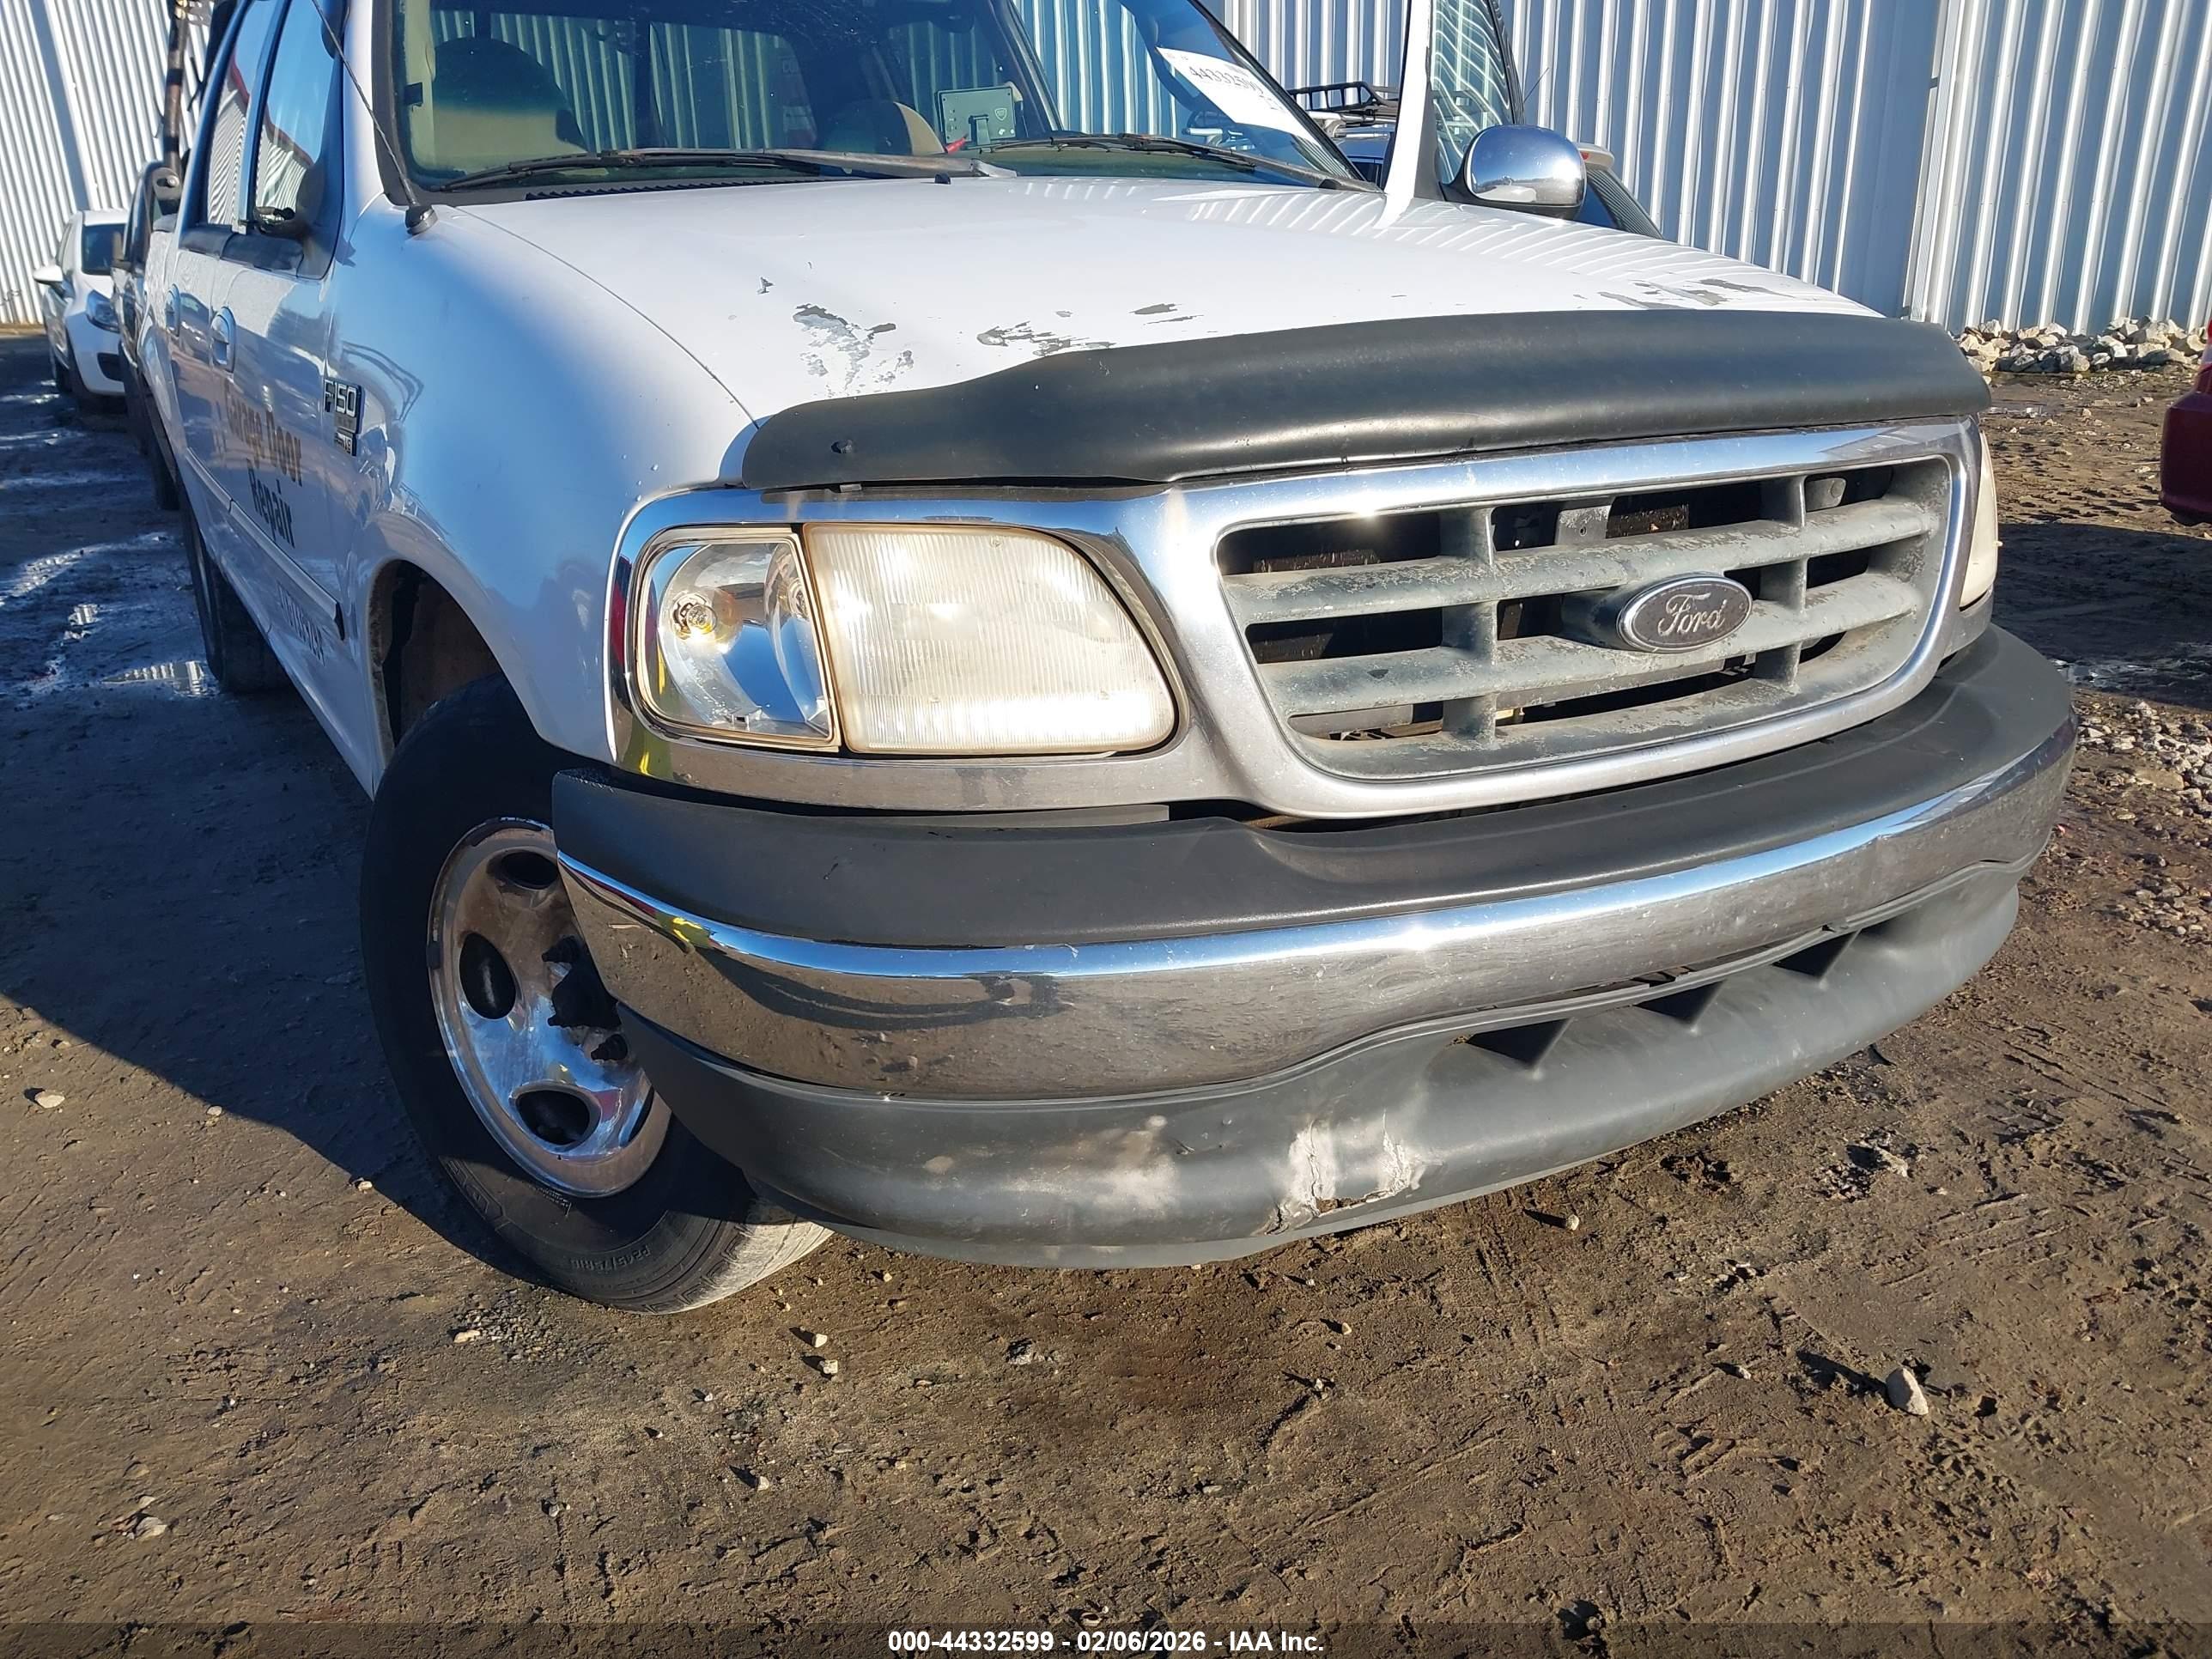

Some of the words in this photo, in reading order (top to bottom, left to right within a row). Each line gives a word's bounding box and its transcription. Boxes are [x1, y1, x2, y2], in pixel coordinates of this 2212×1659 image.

[265, 408, 302, 487] Door
[246, 458, 295, 549] Repair
[1657, 592, 1727, 636] Ford
